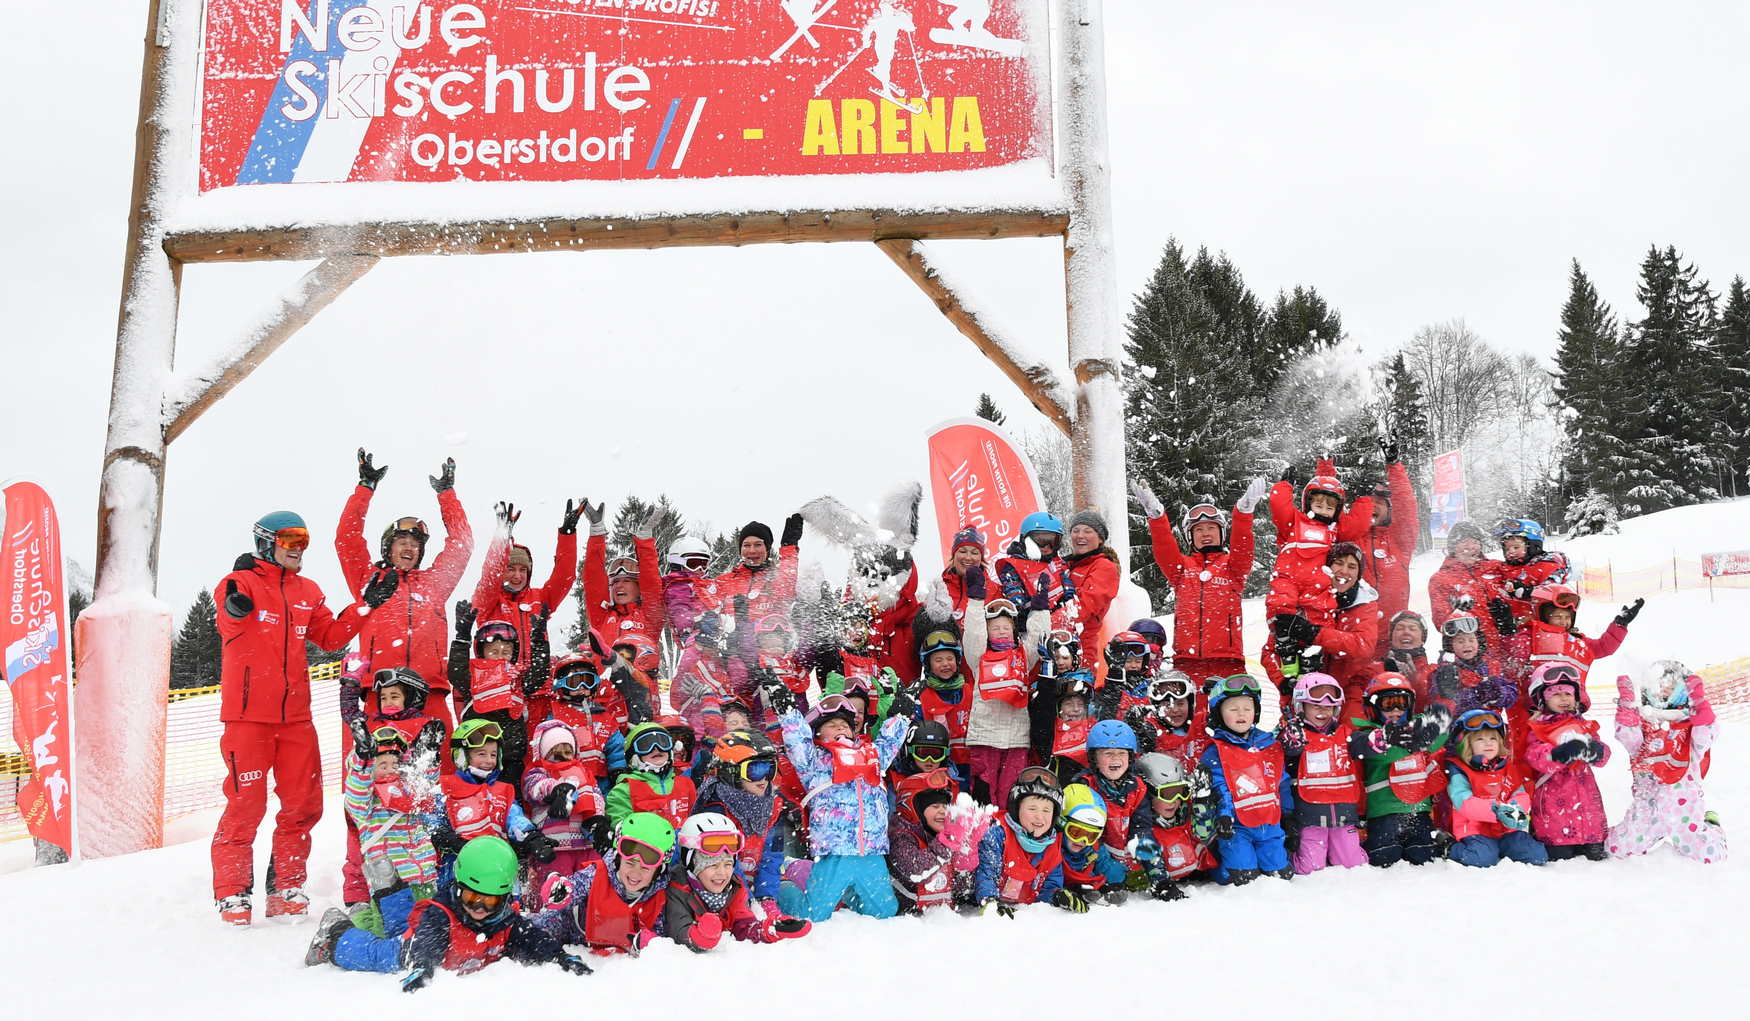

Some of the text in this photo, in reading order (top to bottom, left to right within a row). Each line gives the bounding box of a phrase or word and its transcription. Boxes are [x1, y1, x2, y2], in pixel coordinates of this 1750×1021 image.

[279, 0, 487, 53] Neue
[628, 0, 720, 17] PROFIS!
[280, 51, 651, 121] Skischule
[410, 126, 635, 167] Oberstdorf
[801, 96, 987, 156] ARENA
